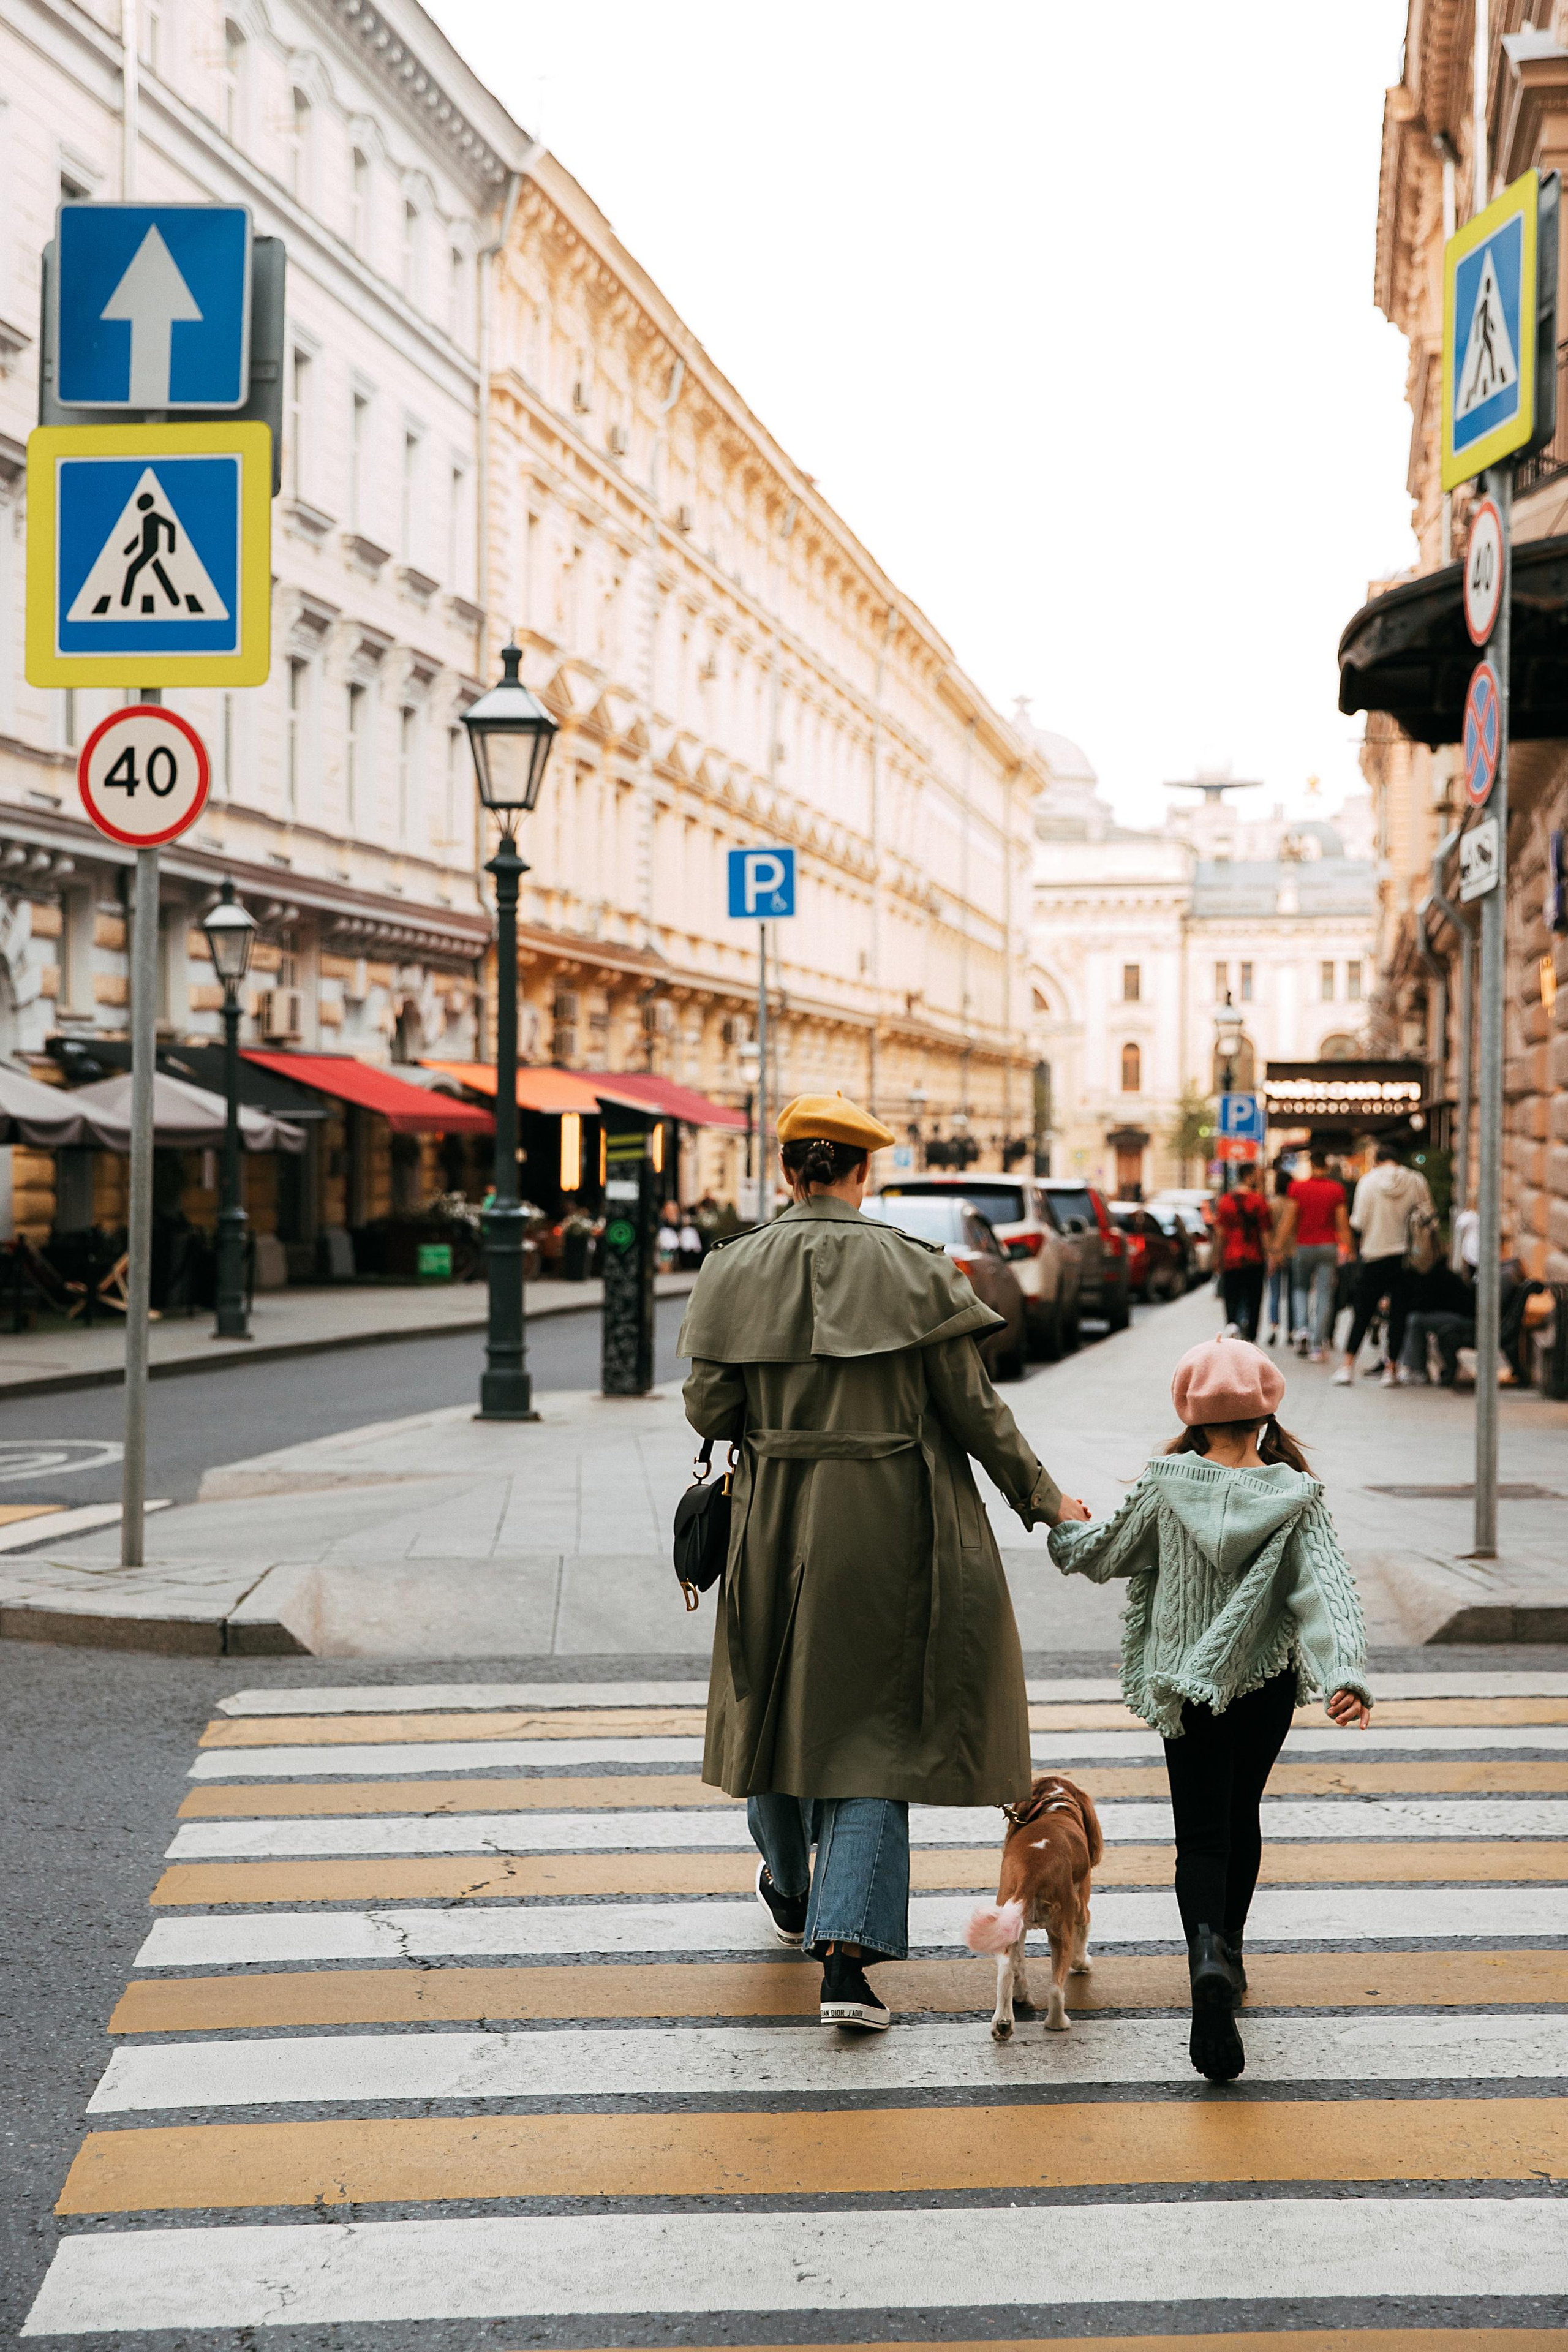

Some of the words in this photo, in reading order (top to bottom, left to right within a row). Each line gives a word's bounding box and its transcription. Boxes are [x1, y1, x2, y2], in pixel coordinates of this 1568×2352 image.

[1472, 541, 1493, 592] 40
[104, 745, 178, 797] 40
[744, 853, 786, 914] P
[1227, 1096, 1253, 1129] P
